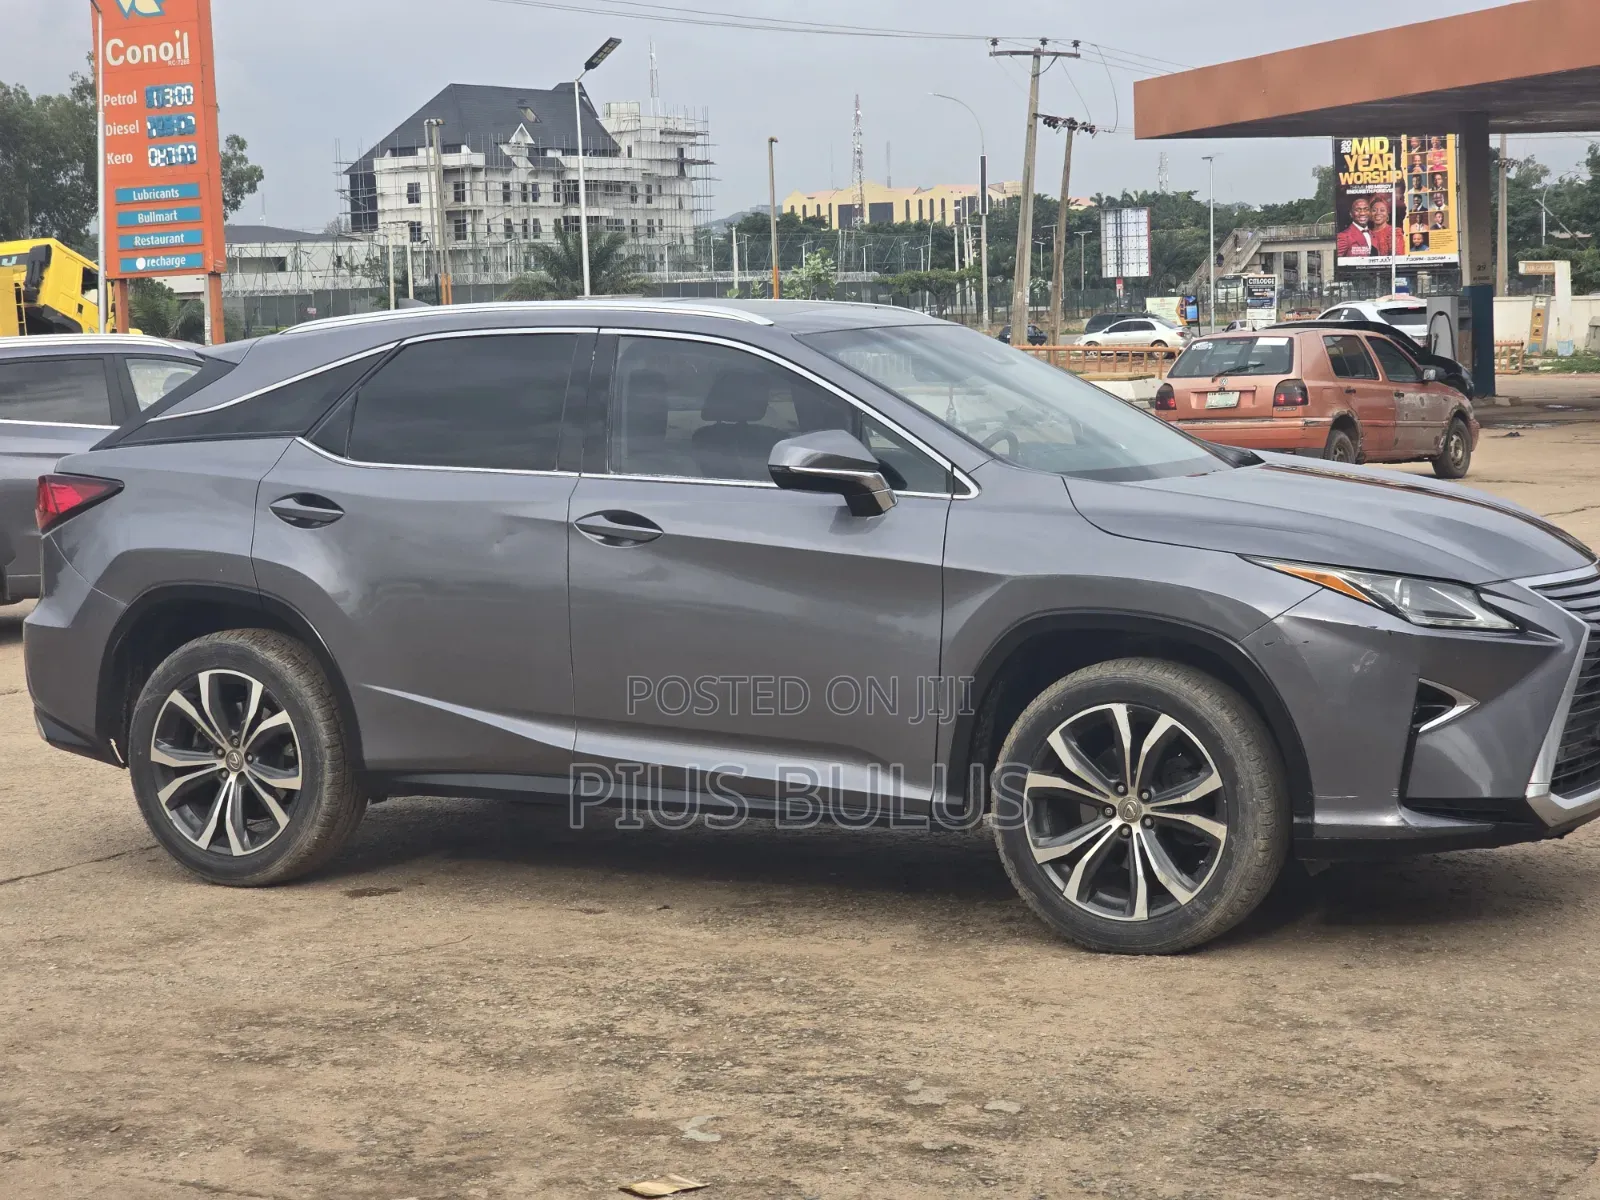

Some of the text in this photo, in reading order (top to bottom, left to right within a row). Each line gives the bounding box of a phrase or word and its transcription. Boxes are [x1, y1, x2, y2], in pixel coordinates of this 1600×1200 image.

[105, 29, 190, 66] Conoil
[103, 90, 137, 107] Petrol
[105, 119, 140, 136] Diesel
[1351, 136, 1389, 155] MID
[107, 152, 133, 165] Kero
[1344, 152, 1395, 172] YEAR
[1339, 170, 1402, 185] WORSHIP
[132, 187, 180, 201] Lubricants
[137, 210, 178, 223] Bullmart
[134, 233, 185, 246] Restaurant
[146, 255, 187, 268] recharge
